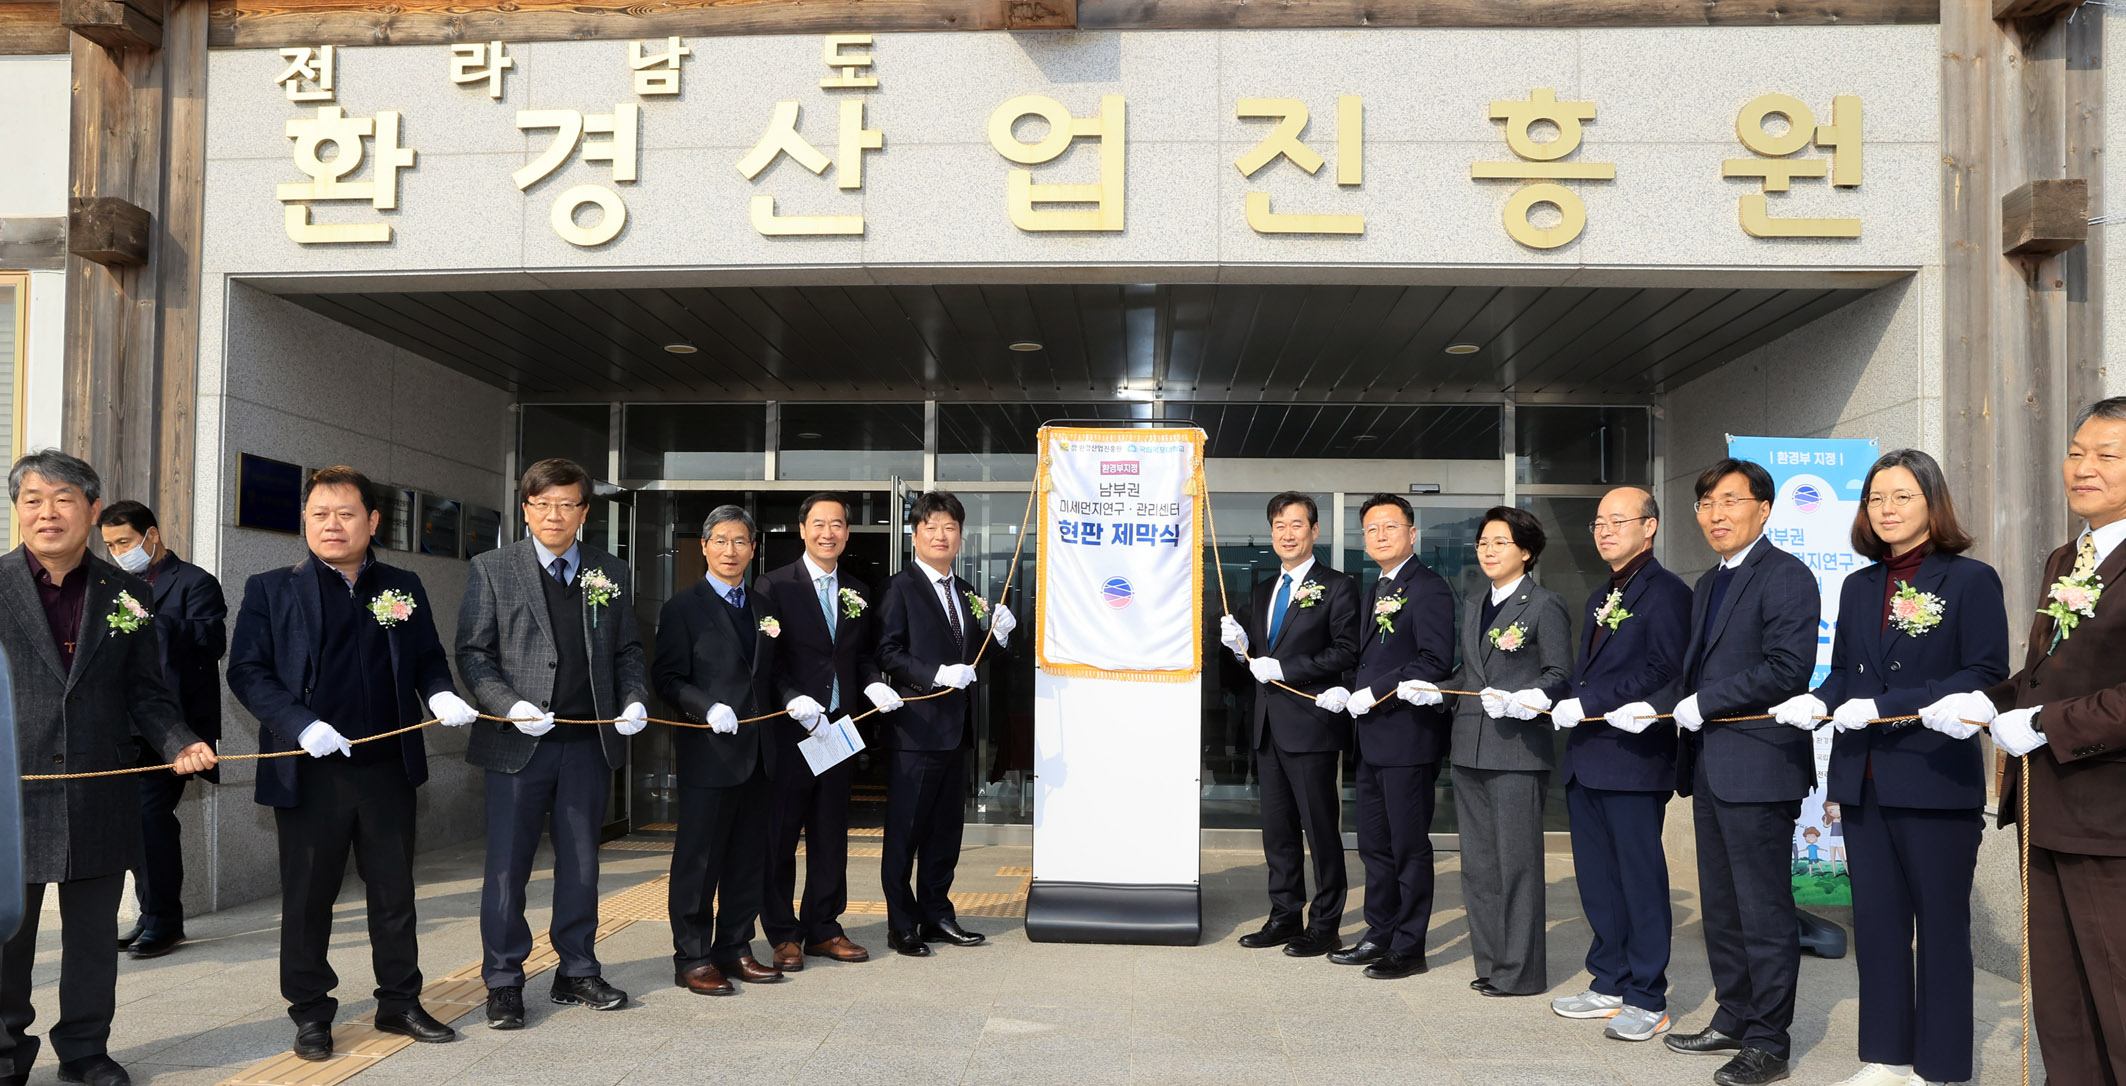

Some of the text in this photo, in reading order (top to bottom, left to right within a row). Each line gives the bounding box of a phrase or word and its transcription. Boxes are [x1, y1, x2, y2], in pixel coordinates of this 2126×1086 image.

[274, 34, 880, 103] 전라남도
[275, 88, 1863, 249] 환경산업진흥원
[1777, 451, 1836, 466] 환경부 지정
[1102, 463, 1138, 474] 환경부지정
[1100, 483, 1140, 498] 남부권
[1059, 500, 1125, 516] 미세먼지연구
[1136, 502, 1180, 517] 관리센터
[1058, 519, 1180, 547] 현판 제막식
